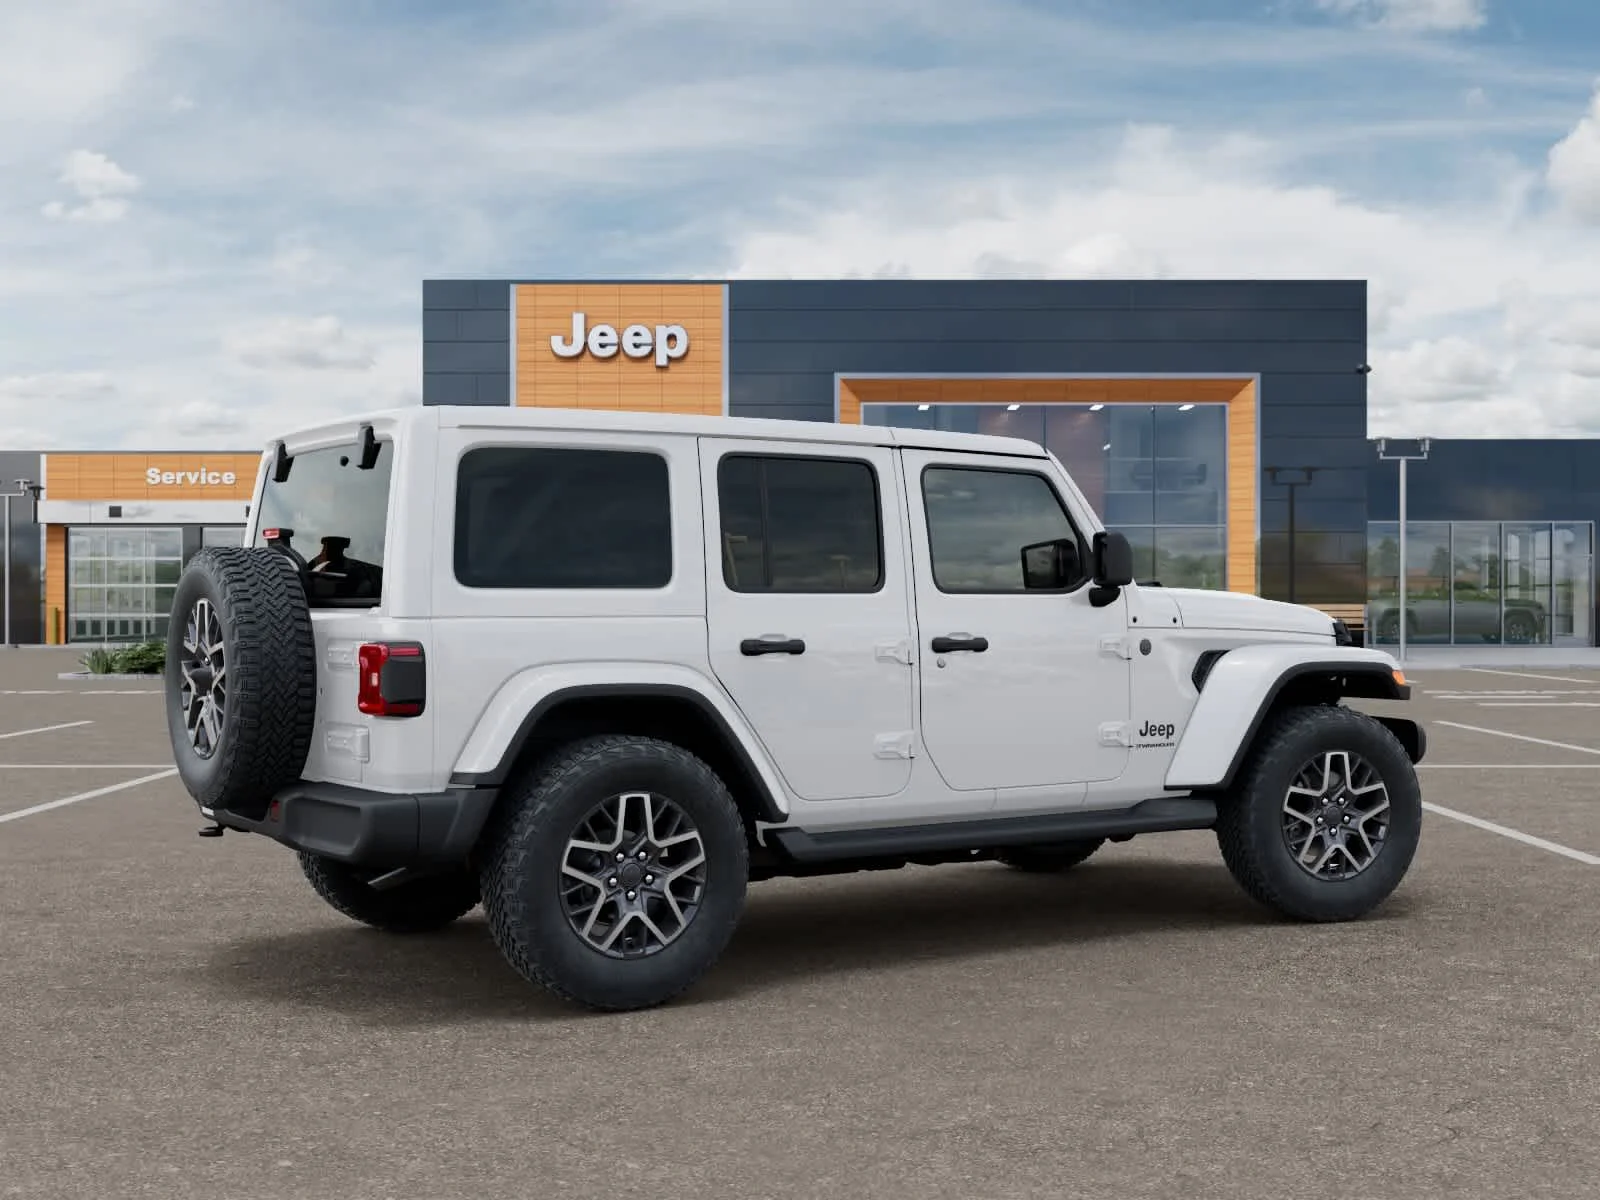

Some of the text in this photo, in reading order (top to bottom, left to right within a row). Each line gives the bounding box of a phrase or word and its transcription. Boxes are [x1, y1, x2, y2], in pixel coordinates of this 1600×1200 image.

[550, 311, 689, 367] Jeep
[146, 465, 236, 486] Service
[1139, 720, 1175, 739] Jeep
